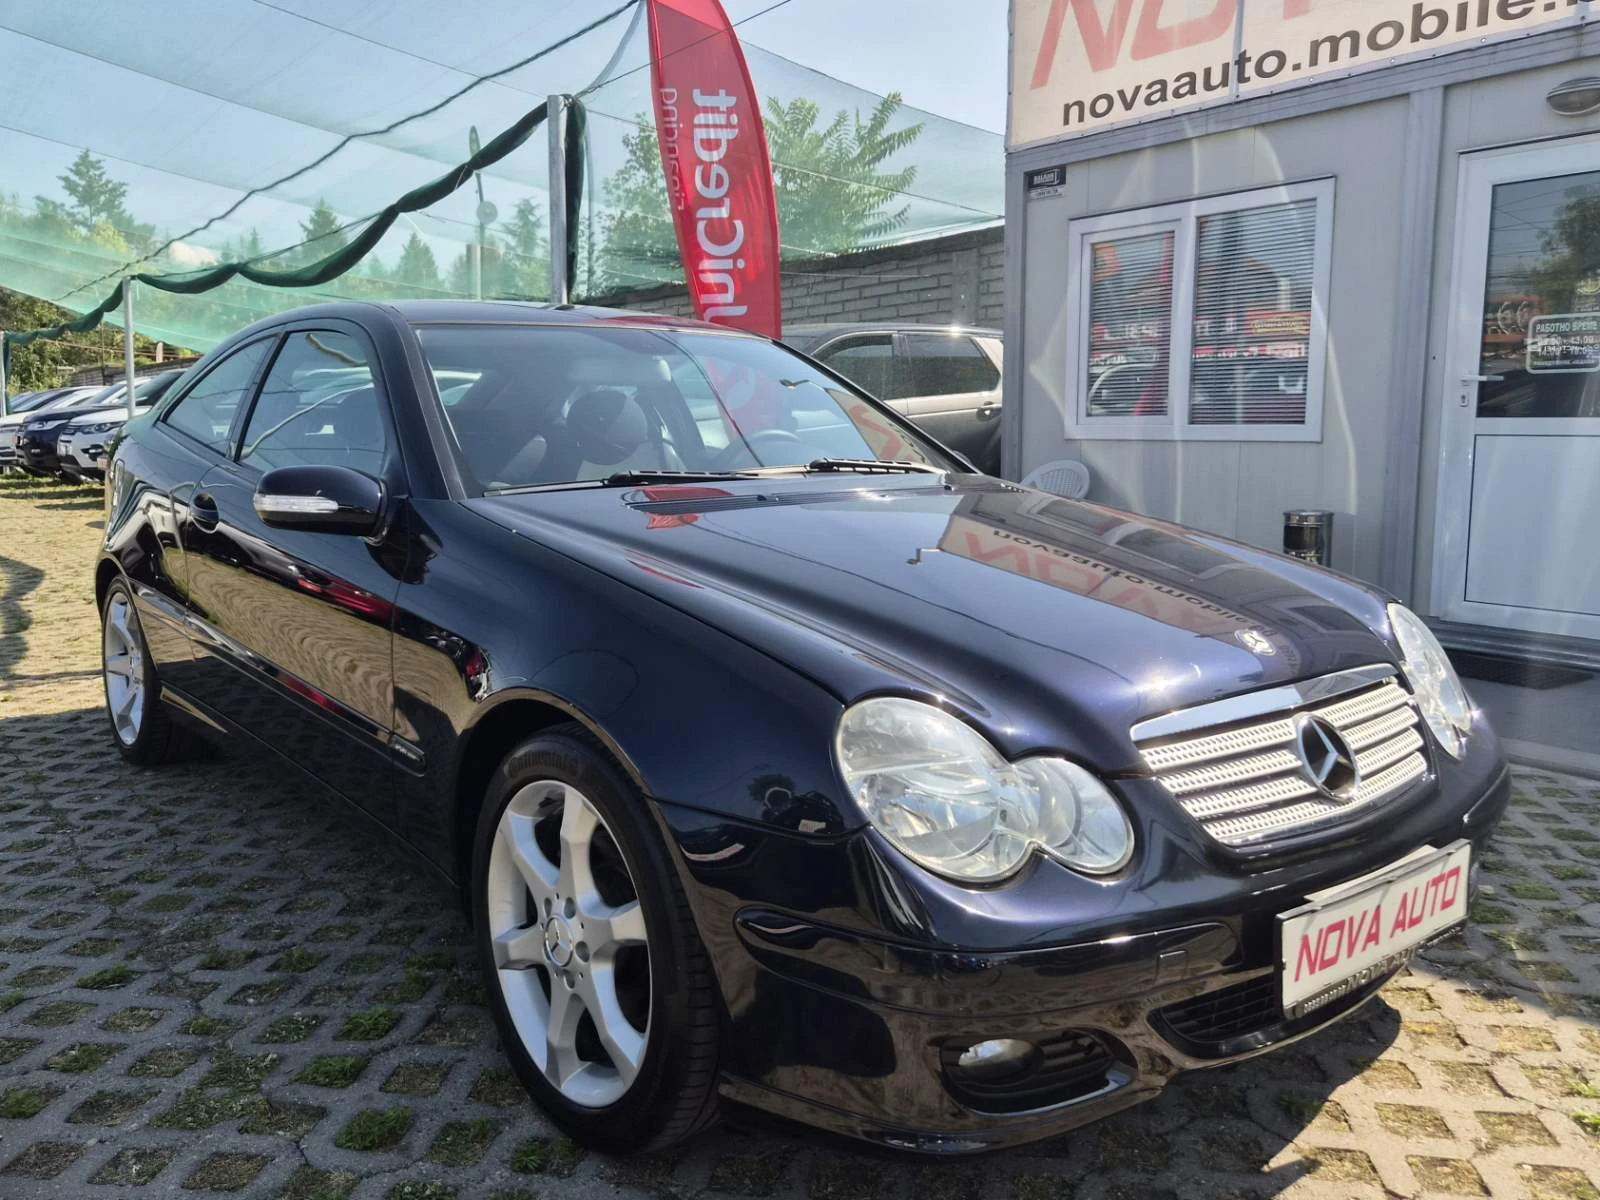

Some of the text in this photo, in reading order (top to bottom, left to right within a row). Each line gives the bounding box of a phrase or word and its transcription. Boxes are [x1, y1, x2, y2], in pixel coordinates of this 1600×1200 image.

[1063, 0, 1600, 126] novaauto.mobile.
[1295, 867, 1460, 982] NOVA AUTO
